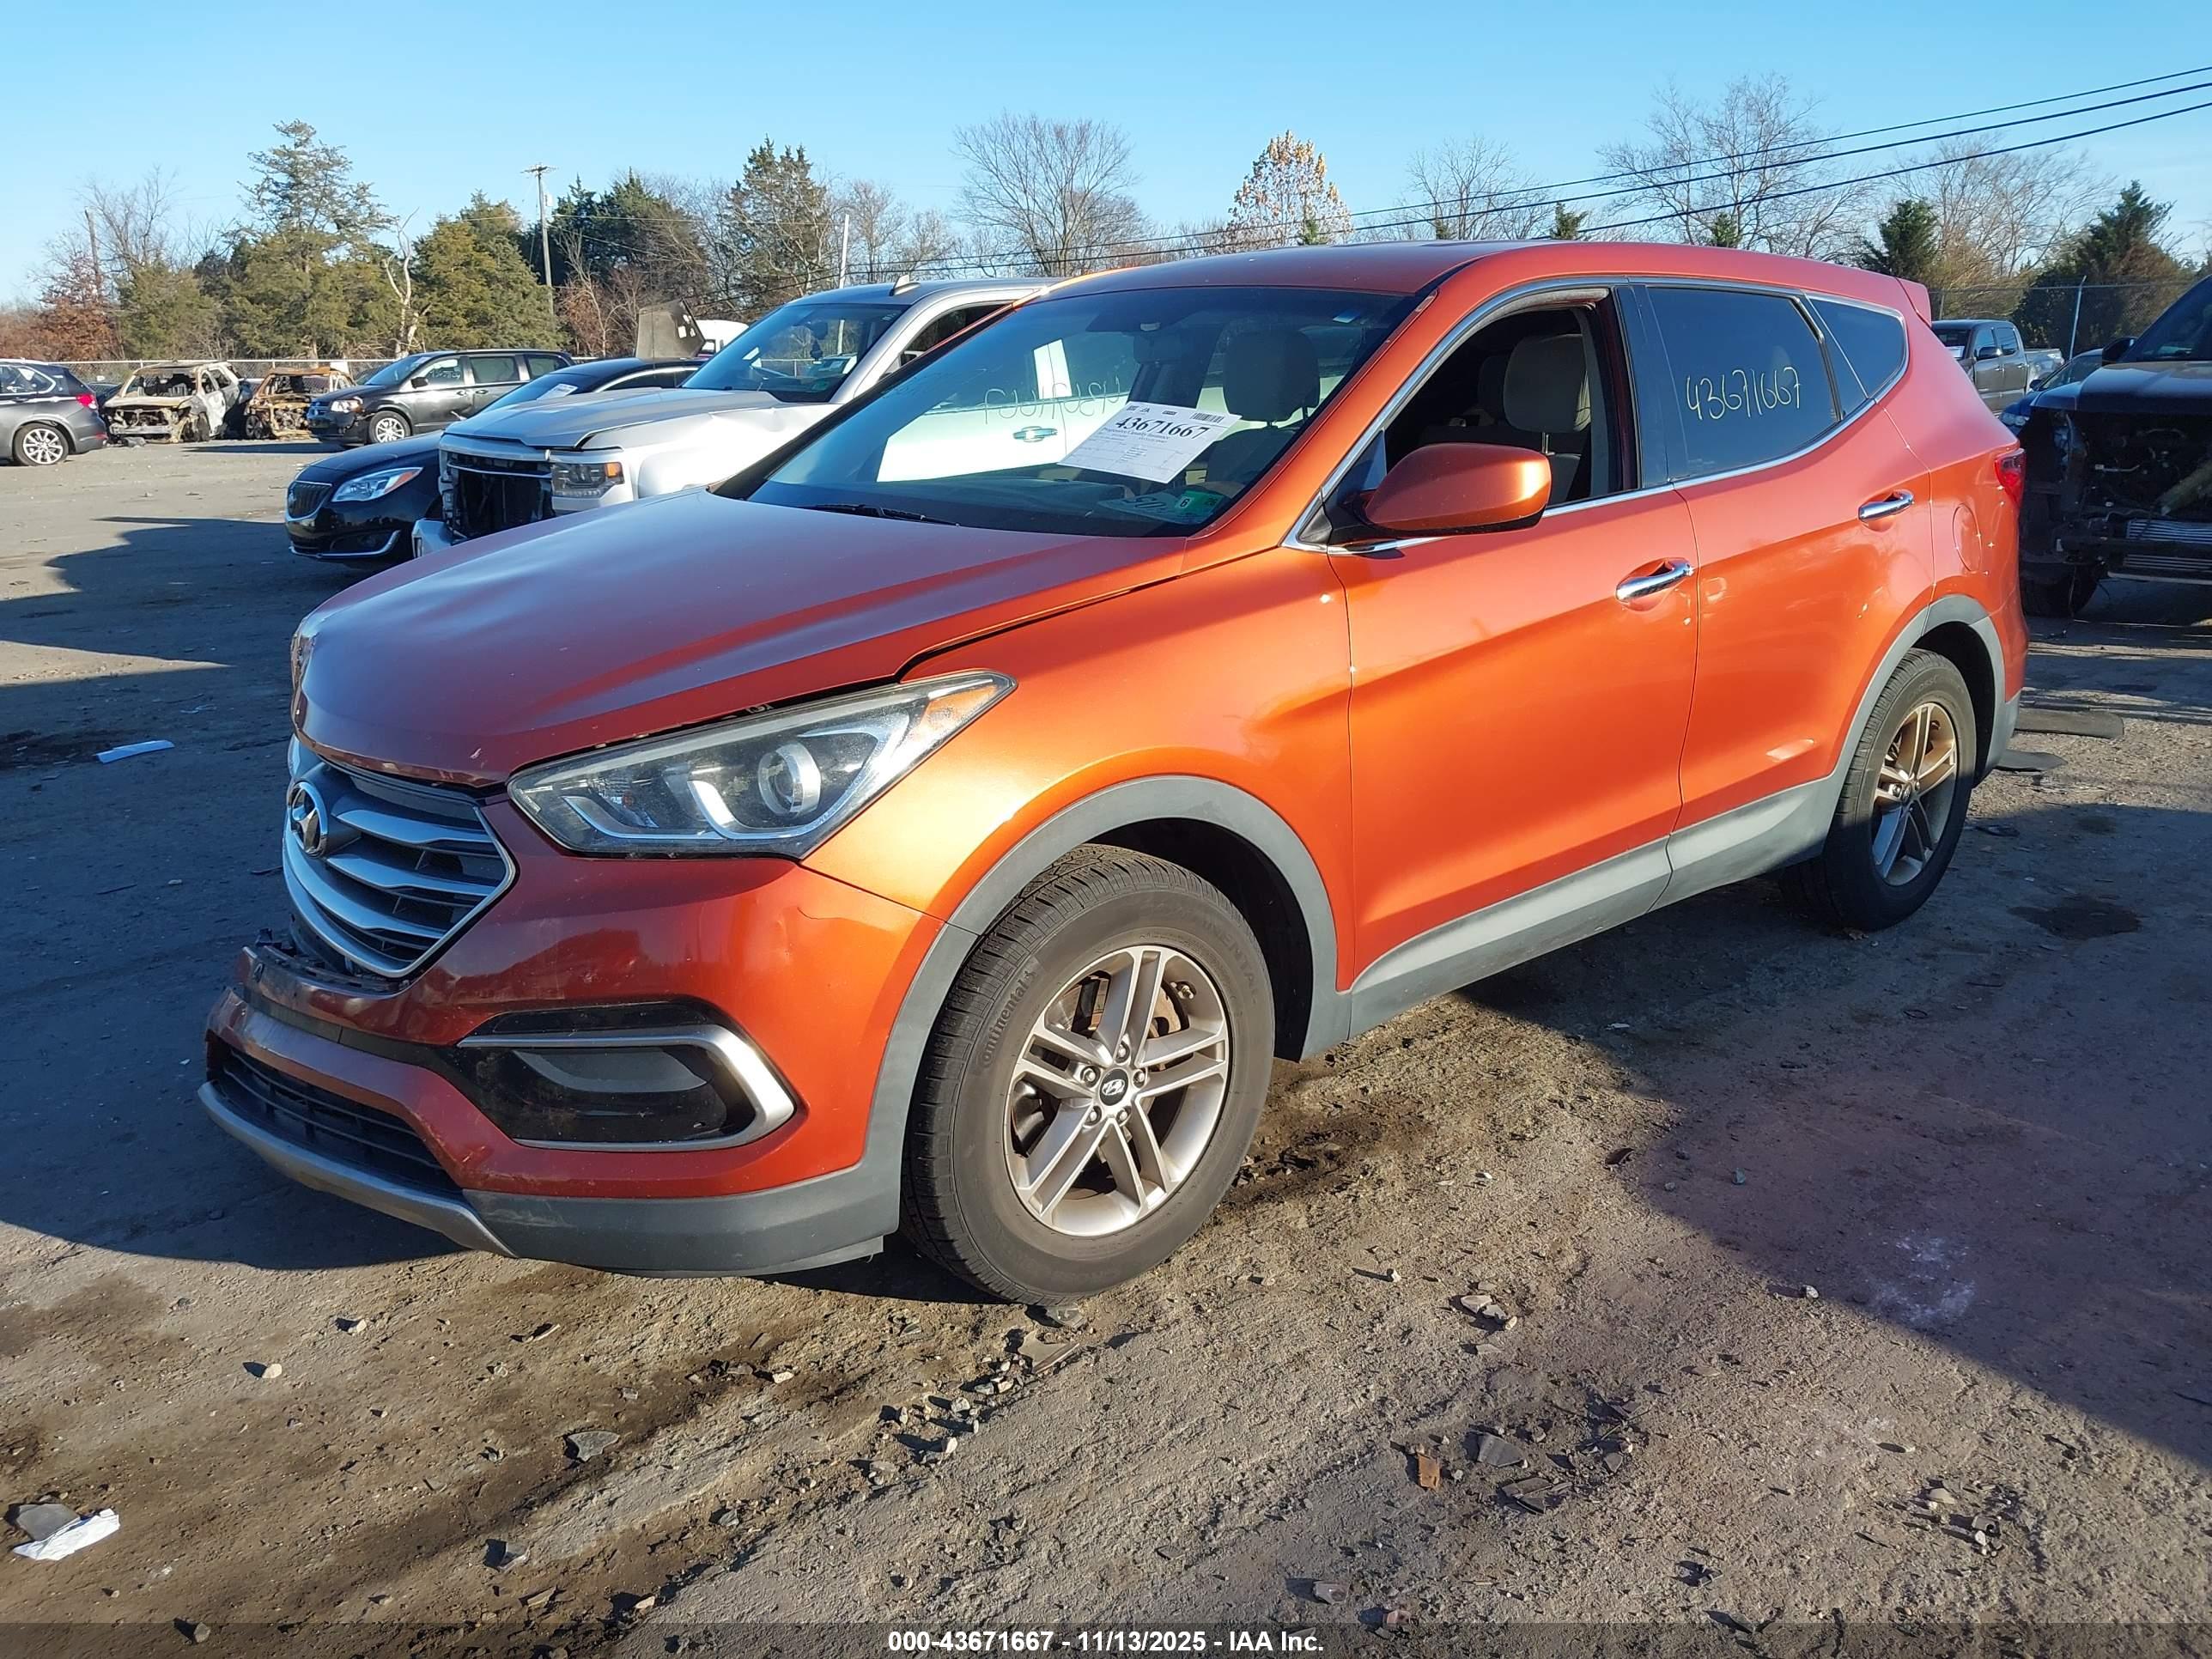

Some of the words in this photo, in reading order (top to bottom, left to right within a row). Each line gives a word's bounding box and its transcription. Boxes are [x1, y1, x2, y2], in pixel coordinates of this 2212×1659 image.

[1686, 367, 1802, 421] 43671667
[1115, 416, 1211, 440] 43671667
[1180, 498, 1190, 507] 6
